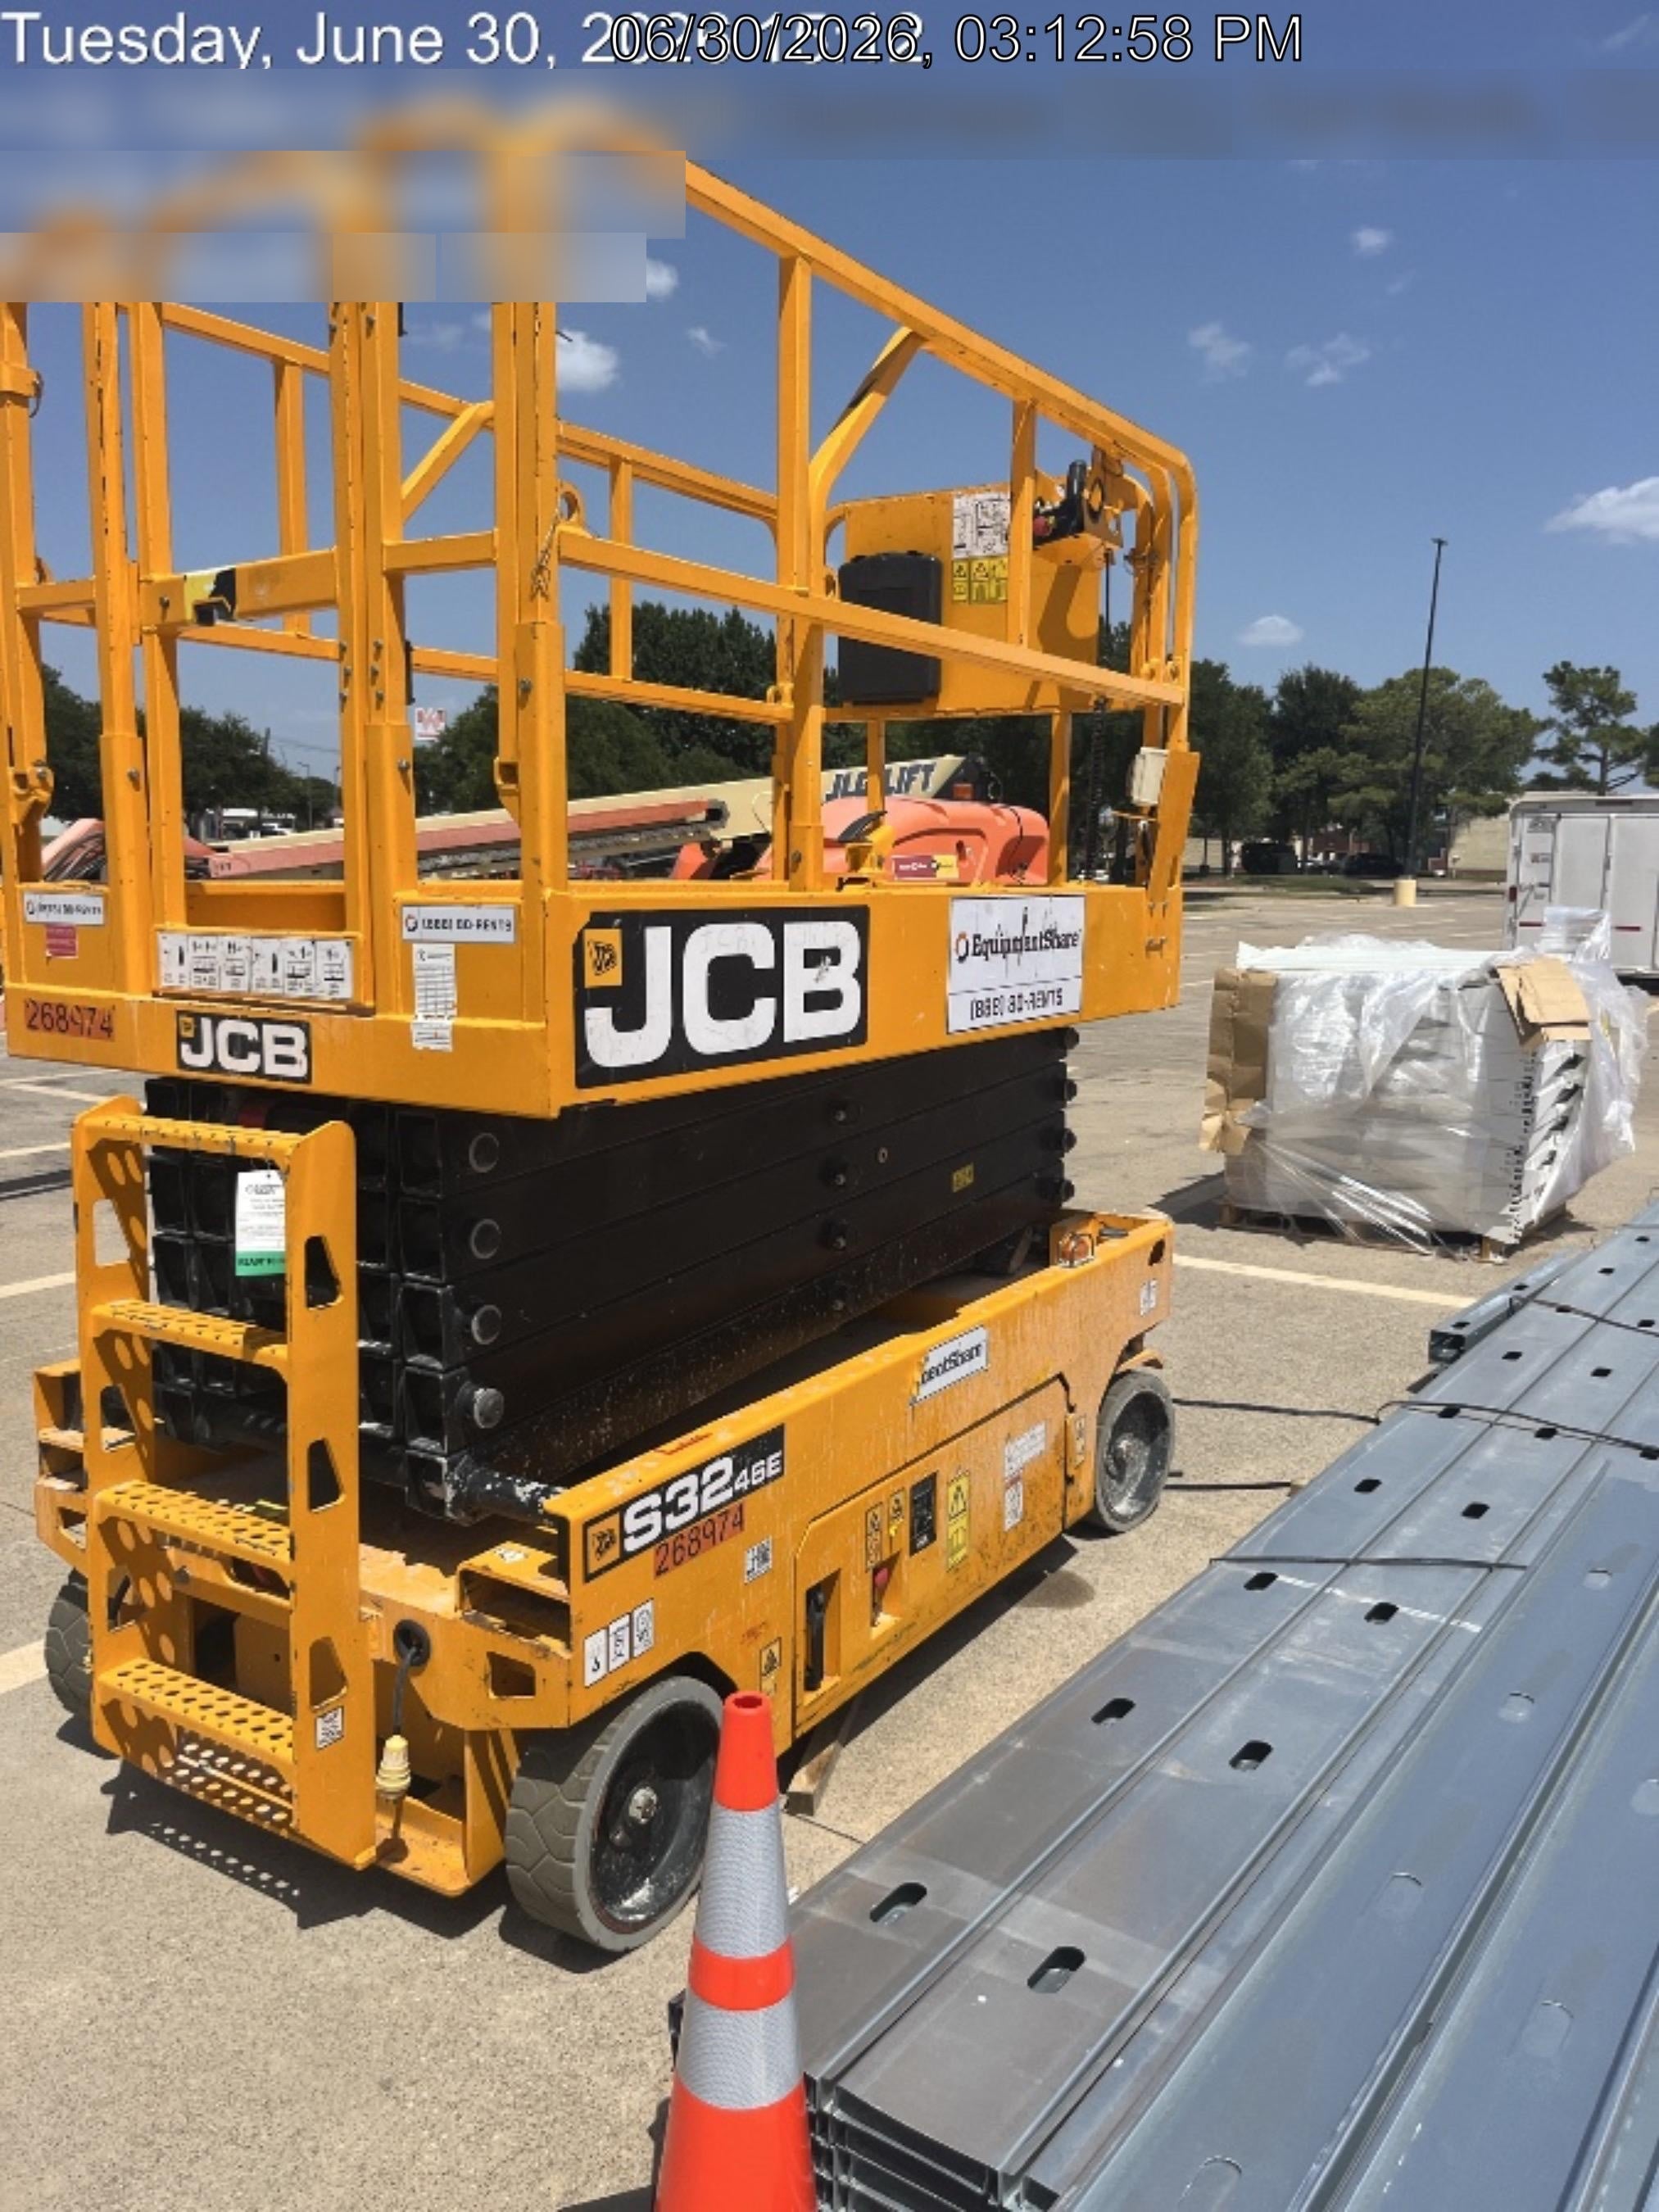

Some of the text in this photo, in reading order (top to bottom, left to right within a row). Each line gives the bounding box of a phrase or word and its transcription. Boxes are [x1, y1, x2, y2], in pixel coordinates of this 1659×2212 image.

[585, 919, 861, 1067] JCB
[181, 1017, 308, 1077] JCB
[655, 1502, 745, 1577] 268974
